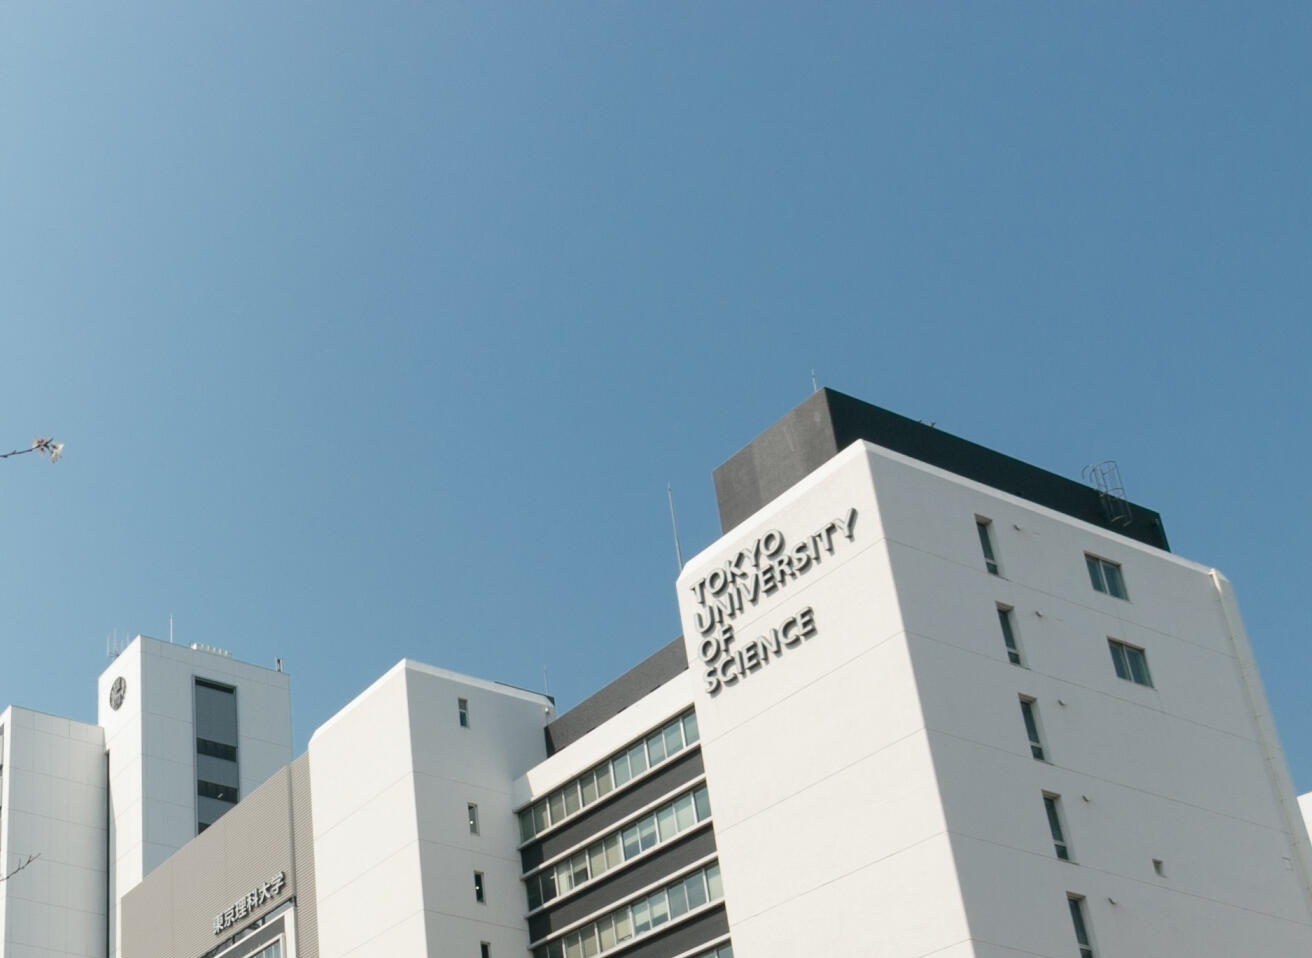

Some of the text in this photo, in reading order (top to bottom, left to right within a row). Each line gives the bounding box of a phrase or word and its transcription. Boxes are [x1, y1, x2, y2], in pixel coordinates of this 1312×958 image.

[689, 529, 786, 605] TOKYO
[694, 507, 858, 634] UNIVERSITY
[698, 624, 735, 664] OF
[702, 605, 818, 698] SCIENCE
[212, 870, 286, 935] 東京理科大学
